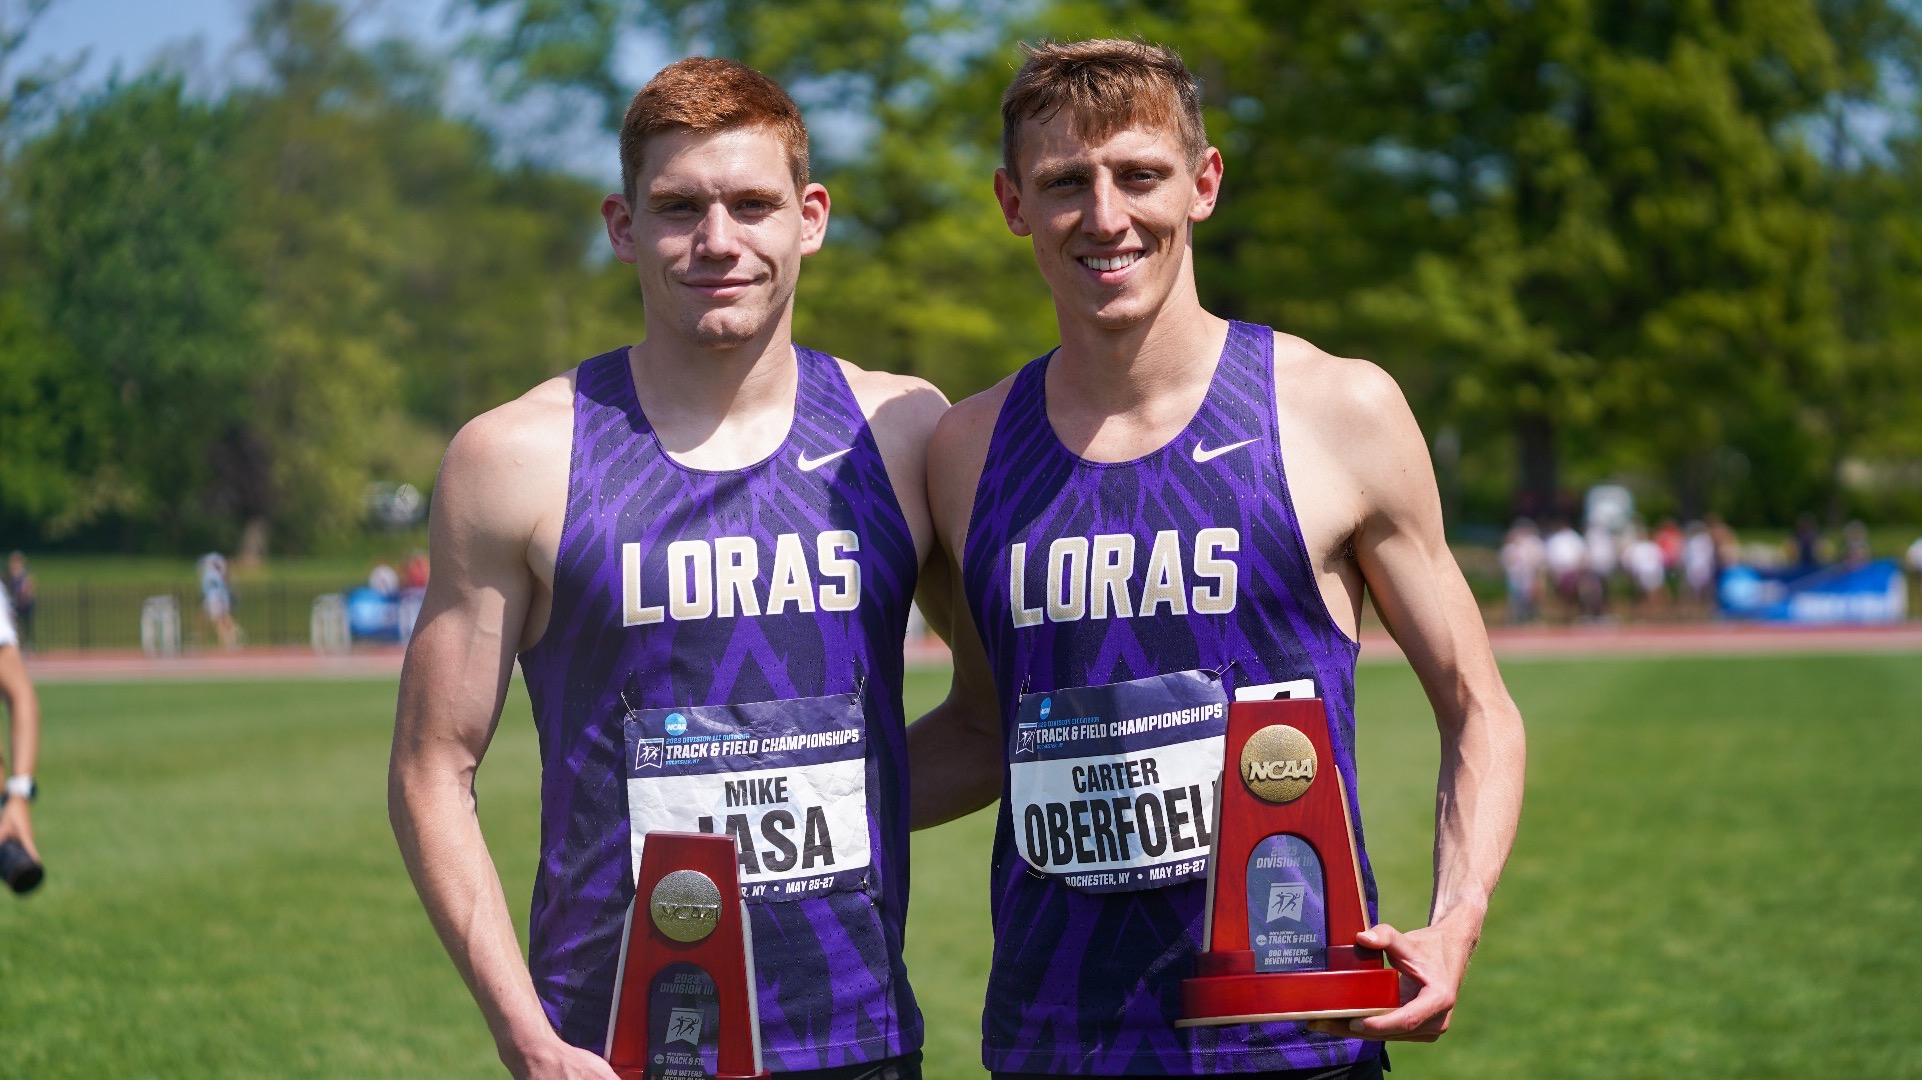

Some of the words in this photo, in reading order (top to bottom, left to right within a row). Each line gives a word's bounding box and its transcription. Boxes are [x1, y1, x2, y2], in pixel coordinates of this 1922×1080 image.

[622, 530, 861, 627] LORAS
[1010, 527, 1239, 628] LORAS
[667, 723, 687, 731] NCAA
[1036, 726, 1069, 743] TRACK
[1071, 725, 1079, 741] &
[1080, 723, 1107, 739] FIELD
[1110, 702, 1223, 737] CHAMPIONSHIPS
[665, 743, 709, 760] TRACK
[709, 742, 720, 757] &
[721, 740, 758, 756] FIELD
[761, 729, 860, 753] CHAMPIONSHIPS
[682, 735, 712, 744] DIVISION
[1072, 757, 1160, 794] CARTER
[1249, 758, 1314, 781] NCAA
[724, 776, 789, 807] MIKE
[1024, 781, 1217, 868] OBERFOEL
[1256, 856, 1300, 868] DIVISION
[1065, 874, 1117, 887] ROCHESTER,
[1118, 872, 1130, 884] NY
[1150, 865, 1173, 881] MAY
[1175, 859, 1206, 877] 25-27
[752, 885, 766, 897] NY
[785, 881, 808, 894] MAY
[808, 876, 835, 891] 25-27
[1268, 935, 1292, 944] TRACK
[1292, 934, 1298, 944] &
[1264, 956, 1293, 965] SEVENTH
[1293, 955, 1313, 964] PLACE
[1282, 948, 1309, 957] METERS
[660, 982, 702, 995] DIVISION
[666, 1056, 689, 1065] TRACK
[678, 1069, 703, 1078] METERS
